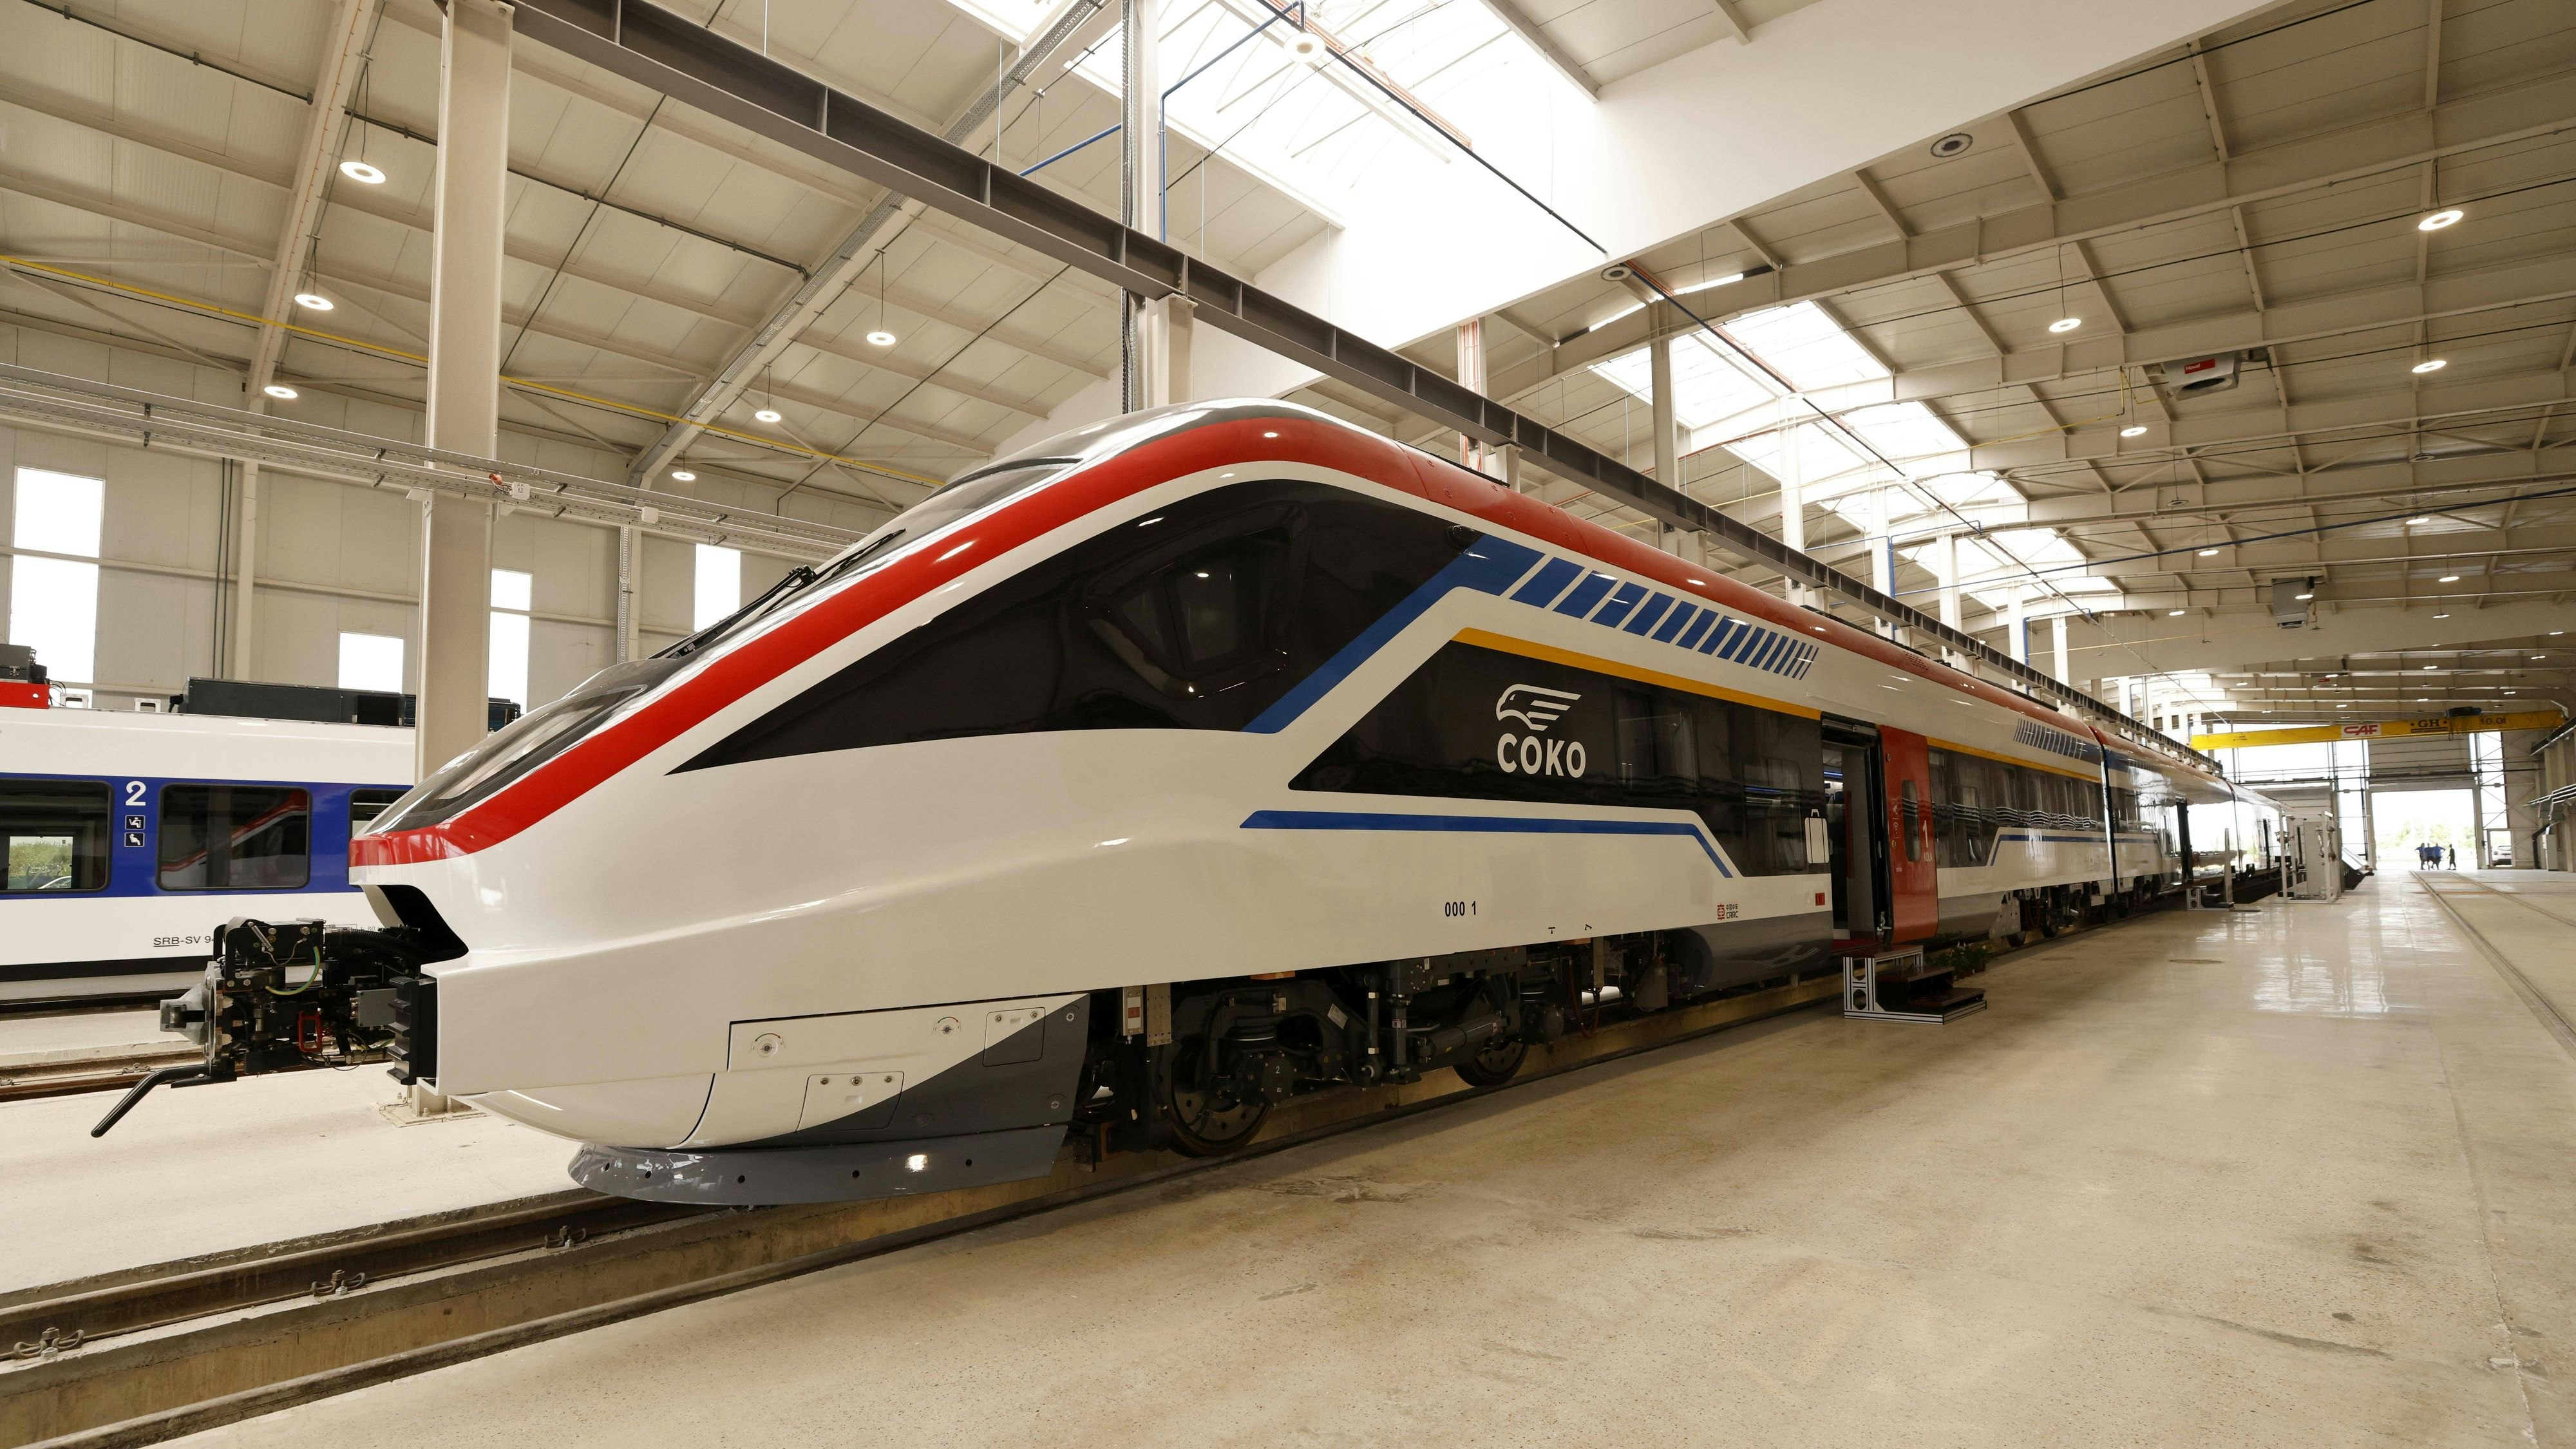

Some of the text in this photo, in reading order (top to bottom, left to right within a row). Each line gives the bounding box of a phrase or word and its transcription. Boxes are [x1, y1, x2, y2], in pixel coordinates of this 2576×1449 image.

[2344, 724, 2378, 735] CAF
[2418, 719, 2439, 728] GH
[126, 781, 146, 806] 2
[1922, 820, 1929, 848] 1
[1444, 900, 1476, 917] 000 1
[153, 936, 201, 947] SRB-SV
